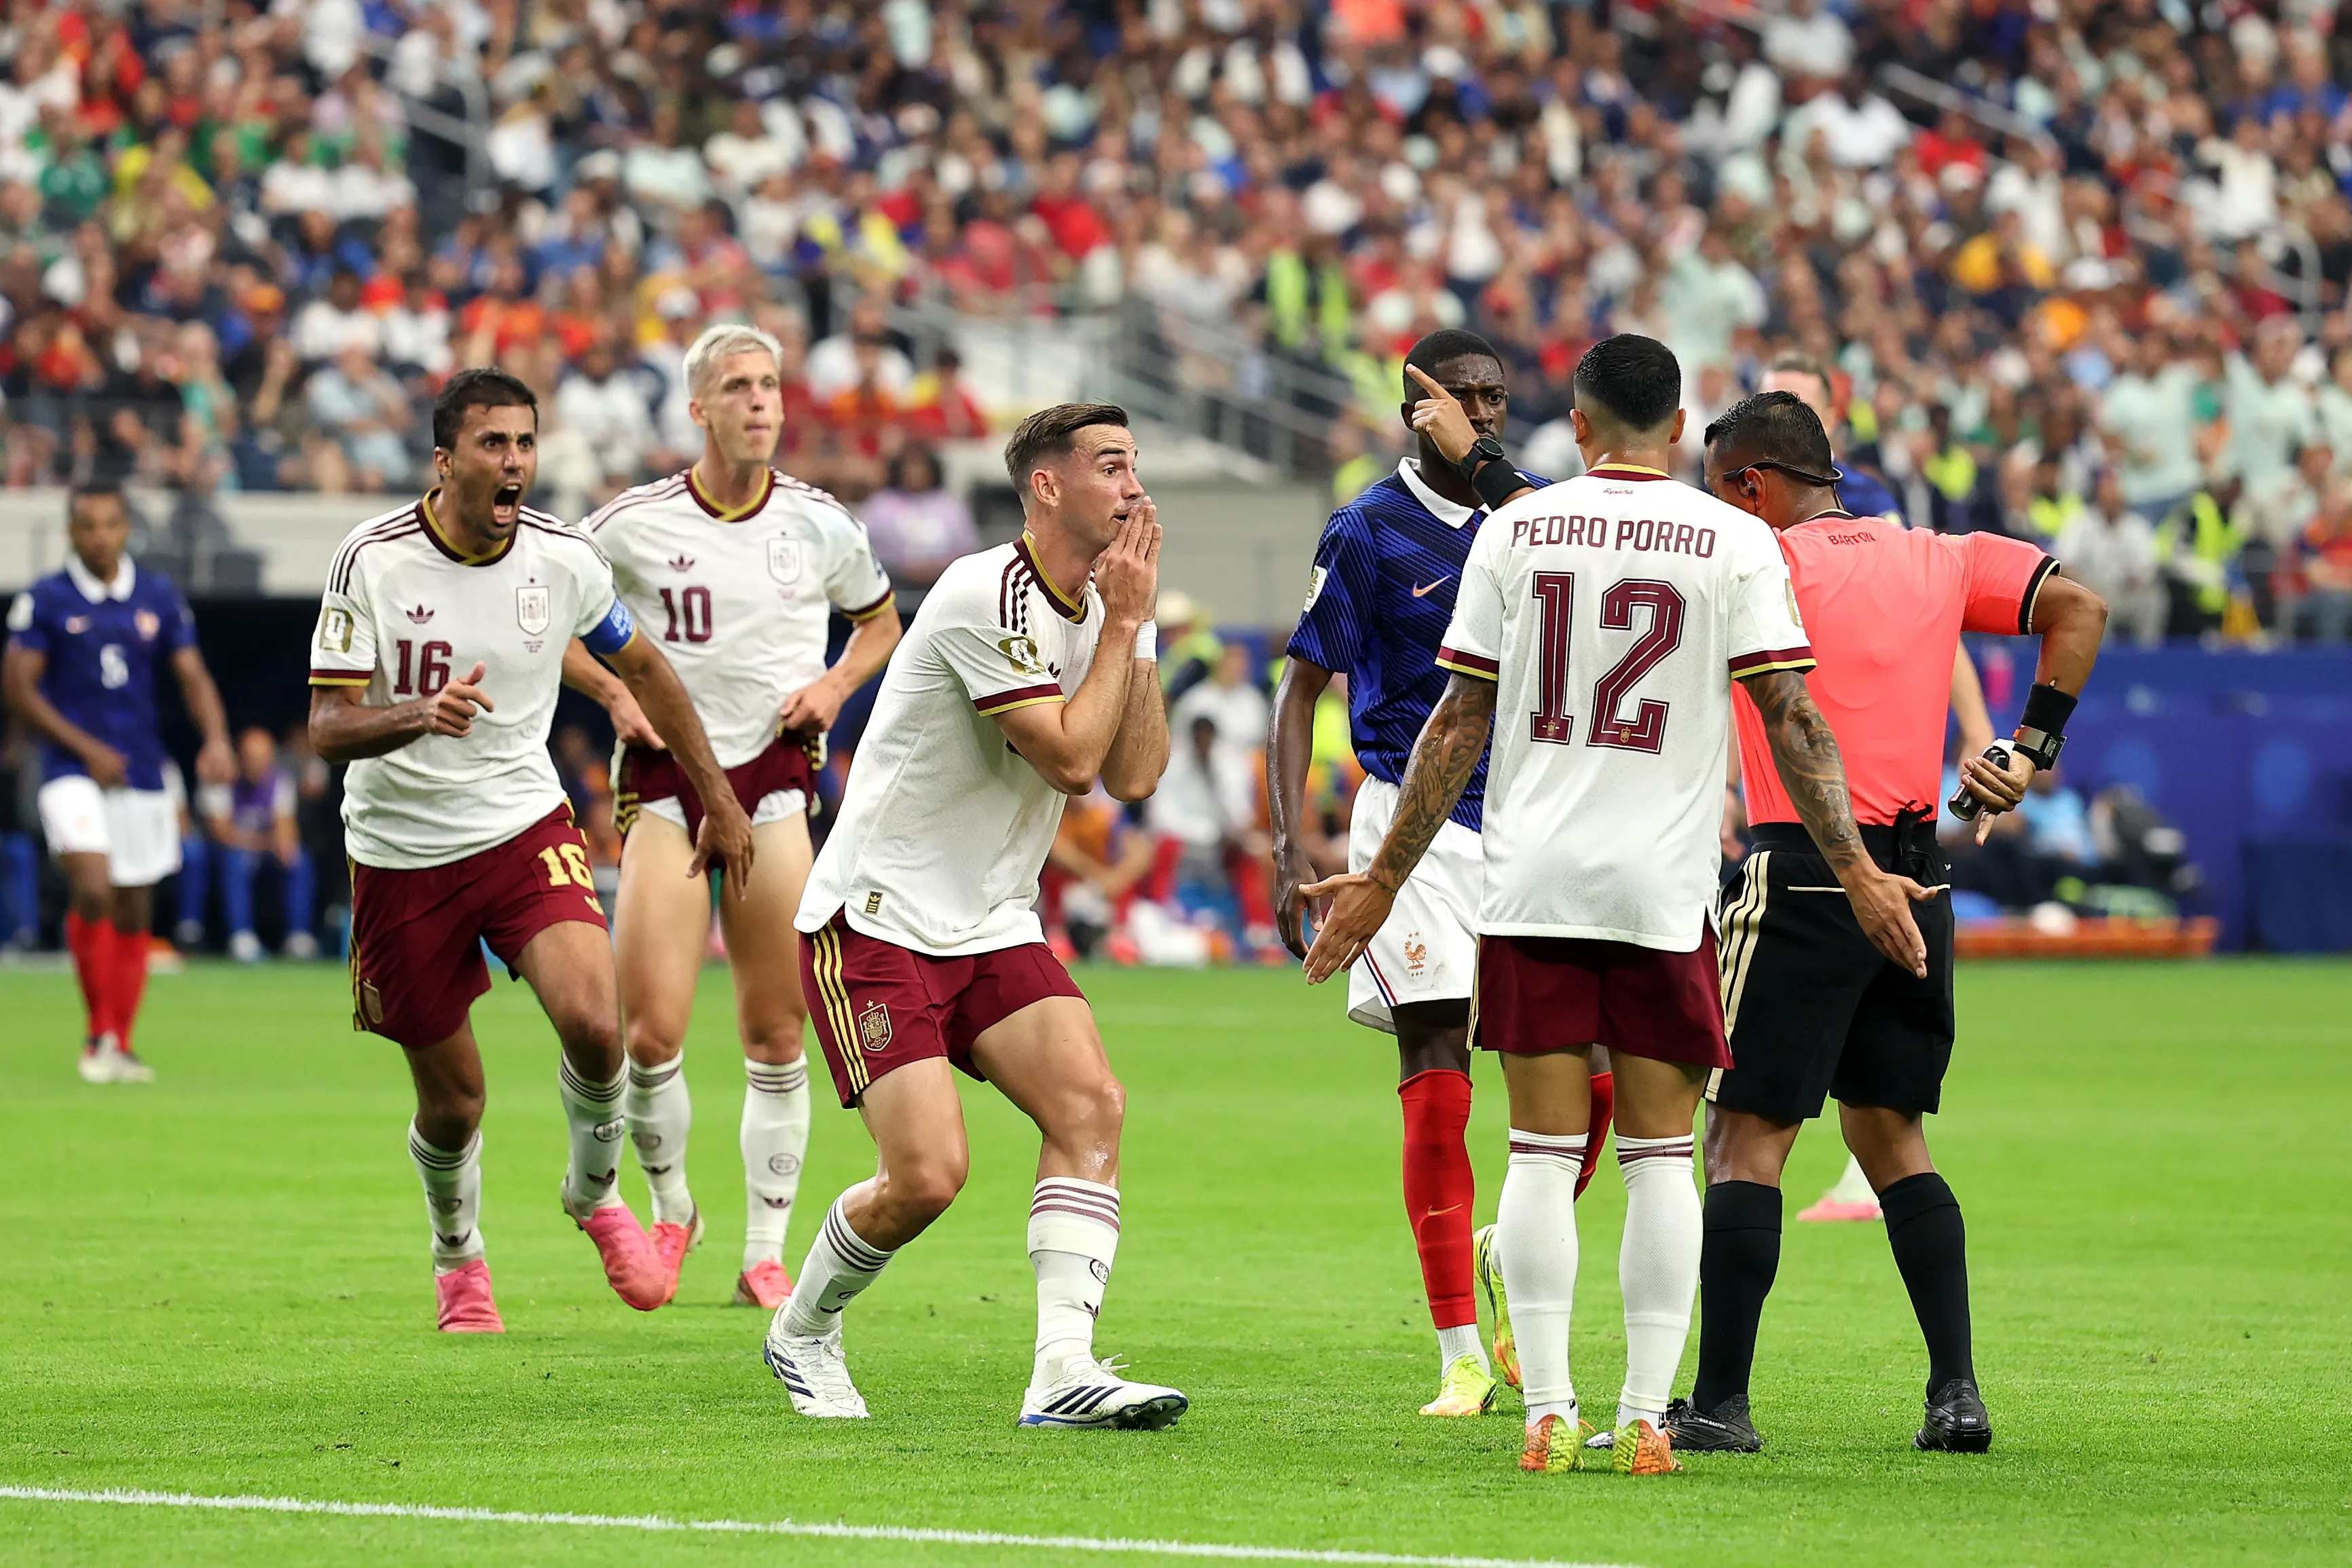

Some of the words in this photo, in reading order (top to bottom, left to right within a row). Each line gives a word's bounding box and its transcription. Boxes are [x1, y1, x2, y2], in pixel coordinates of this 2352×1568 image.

[1511, 515, 1607, 548] PEDRO
[1615, 519, 1716, 559] PORRO
[1827, 531, 1876, 545] BARTON
[659, 586, 712, 643] 10
[394, 639, 452, 697] 16
[1530, 570, 1687, 755] 12
[538, 842, 595, 891] 16
